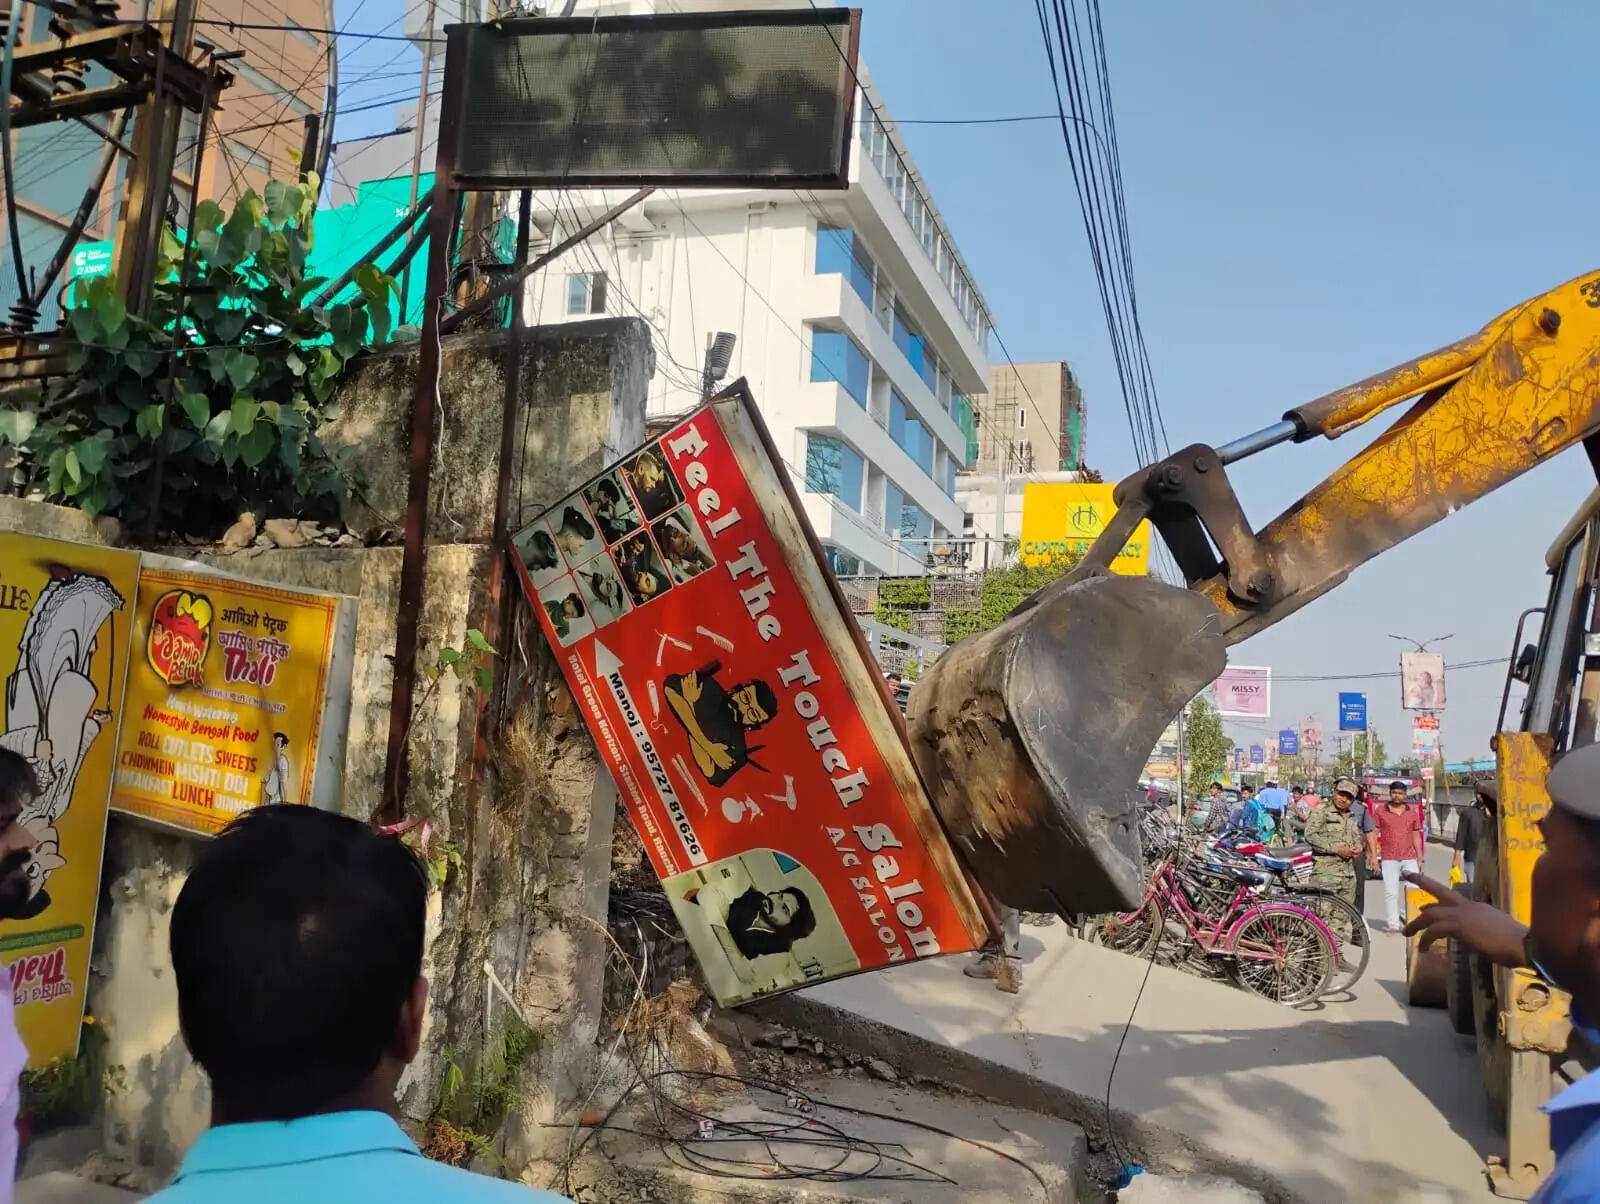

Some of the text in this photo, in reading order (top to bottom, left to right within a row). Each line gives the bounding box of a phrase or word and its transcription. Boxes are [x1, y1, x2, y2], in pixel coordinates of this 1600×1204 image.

[223, 647, 276, 686] Thali
[668, 423, 941, 957] Feel The Touch Salon
[1232, 685, 1260, 694] MISSY
[143, 703, 259, 742] Homestyle Bengali Food
[121, 751, 175, 777] CHOWMEIN
[224, 772, 248, 796] DOI
[138, 731, 160, 750] ROLL
[215, 750, 257, 773] SWEETS
[568, 654, 587, 686] Hotel
[582, 687, 601, 718] Green
[619, 765, 641, 805] Station
[653, 837, 679, 877] Ranchi
[609, 672, 640, 727] Manoj
[641, 741, 673, 794] 95727
[669, 801, 701, 855] 81626
[172, 781, 214, 809] LUNCH
[826, 826, 905, 961] A/C SALON
